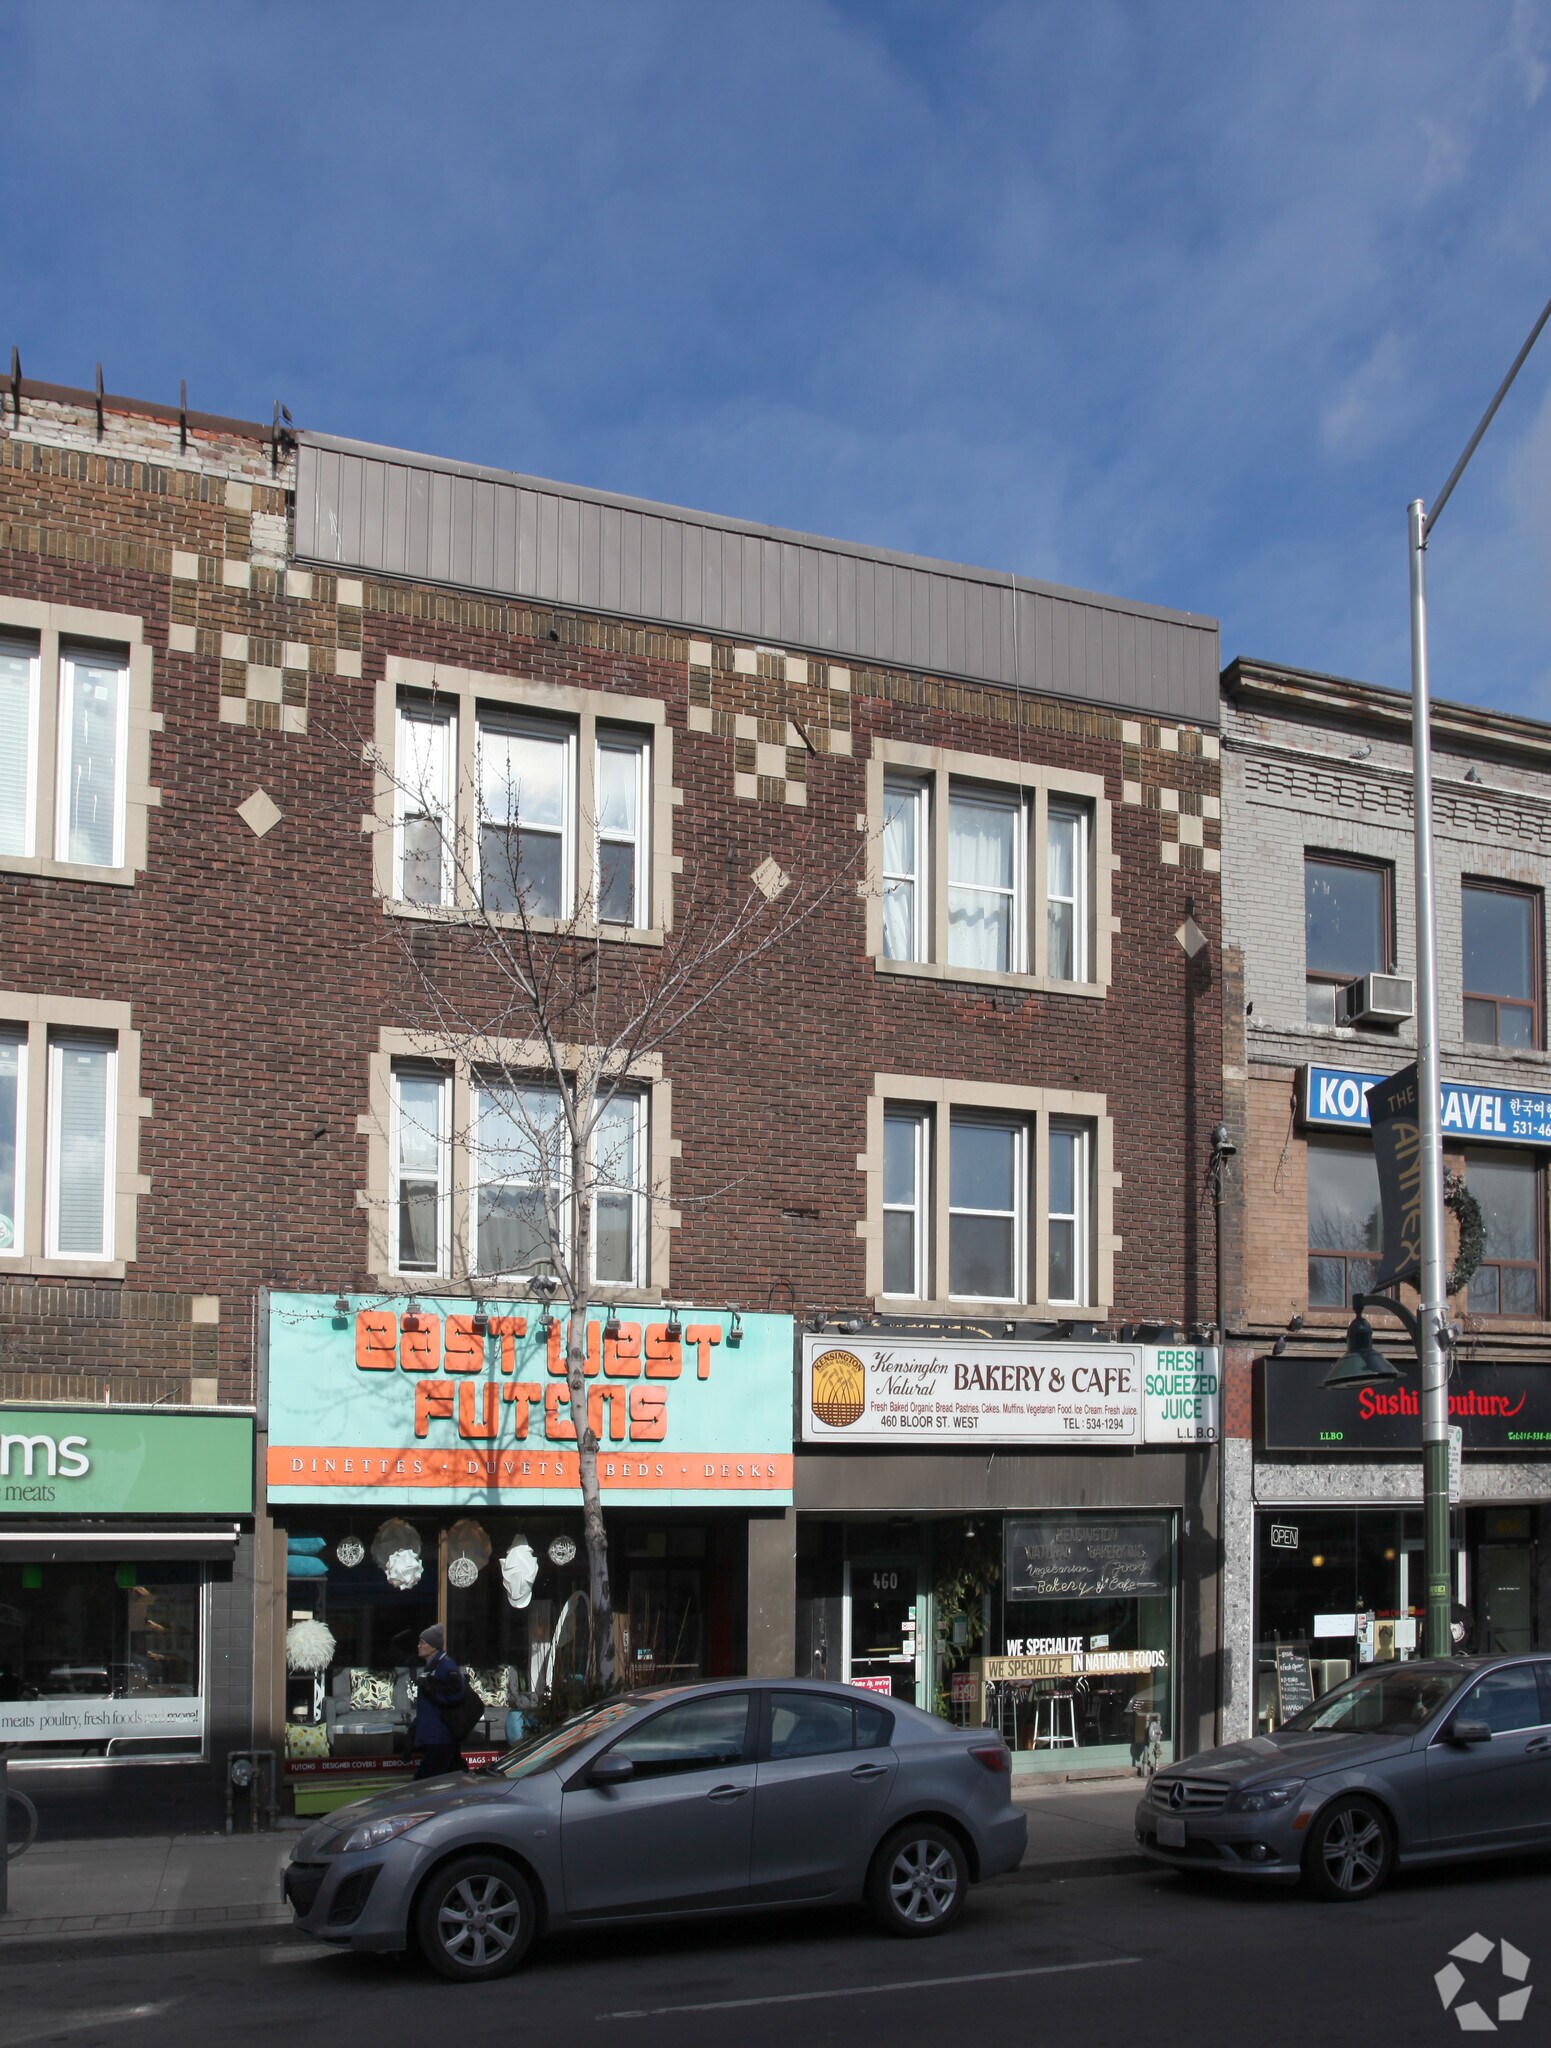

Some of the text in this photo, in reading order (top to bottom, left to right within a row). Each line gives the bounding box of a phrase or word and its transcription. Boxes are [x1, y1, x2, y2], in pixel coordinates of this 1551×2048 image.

[1387, 1085, 1416, 1113] THE
[1441, 1092, 1507, 1132] AVEL
[814, 1352, 863, 1372] KENSINGTON
[870, 1351, 949, 1381] Kensington
[1157, 1350, 1204, 1371] FRESH
[876, 1375, 937, 1395] Natural
[953, 1363, 1046, 1391] BAKERY
[1048, 1367, 1065, 1393] &
[1071, 1368, 1131, 1397] CAFE
[1145, 1374, 1217, 1396] SQUEEZED
[870, 1401, 888, 1412] Fresh
[890, 1401, 909, 1412] Baked
[910, 1402, 933, 1415] Organic
[1026, 1403, 1056, 1416] Vegetarian
[1074, 1404, 1083, 1414] Ice
[1104, 1404, 1120, 1415] Fresh
[1161, 1398, 1202, 1420] JUICE
[1358, 1386, 1526, 1420] Sushi outure
[880, 1415, 979, 1429] 460 BLOOR ST. WEST
[1086, 1418, 1124, 1430] 534-1294
[1177, 1427, 1218, 1439] L.L.B.O.
[1319, 1432, 1343, 1441] LLBO
[291, 1457, 777, 1479] DINETTES DUVETS BEDS DESKS
[5, 1485, 56, 1501] meats
[1273, 1528, 1297, 1545] OPEN
[873, 1572, 898, 1590] 460
[1037, 1577, 1094, 1597] Bakery
[1007, 1636, 1083, 1656] WE SPECIALIZE
[1072, 1649, 1169, 1672] IN NATURAL FOODS.
[1, 1715, 35, 1728] meats
[40, 1711, 82, 1730] poultry,
[84, 1710, 110, 1727] fresh
[112, 1709, 143, 1725] foods
[291, 1763, 316, 1771] FUTONS
[322, 1761, 351, 1769] DESIGNER
[352, 1760, 377, 1769] COVERS
[468, 1756, 486, 1764] BAGS
